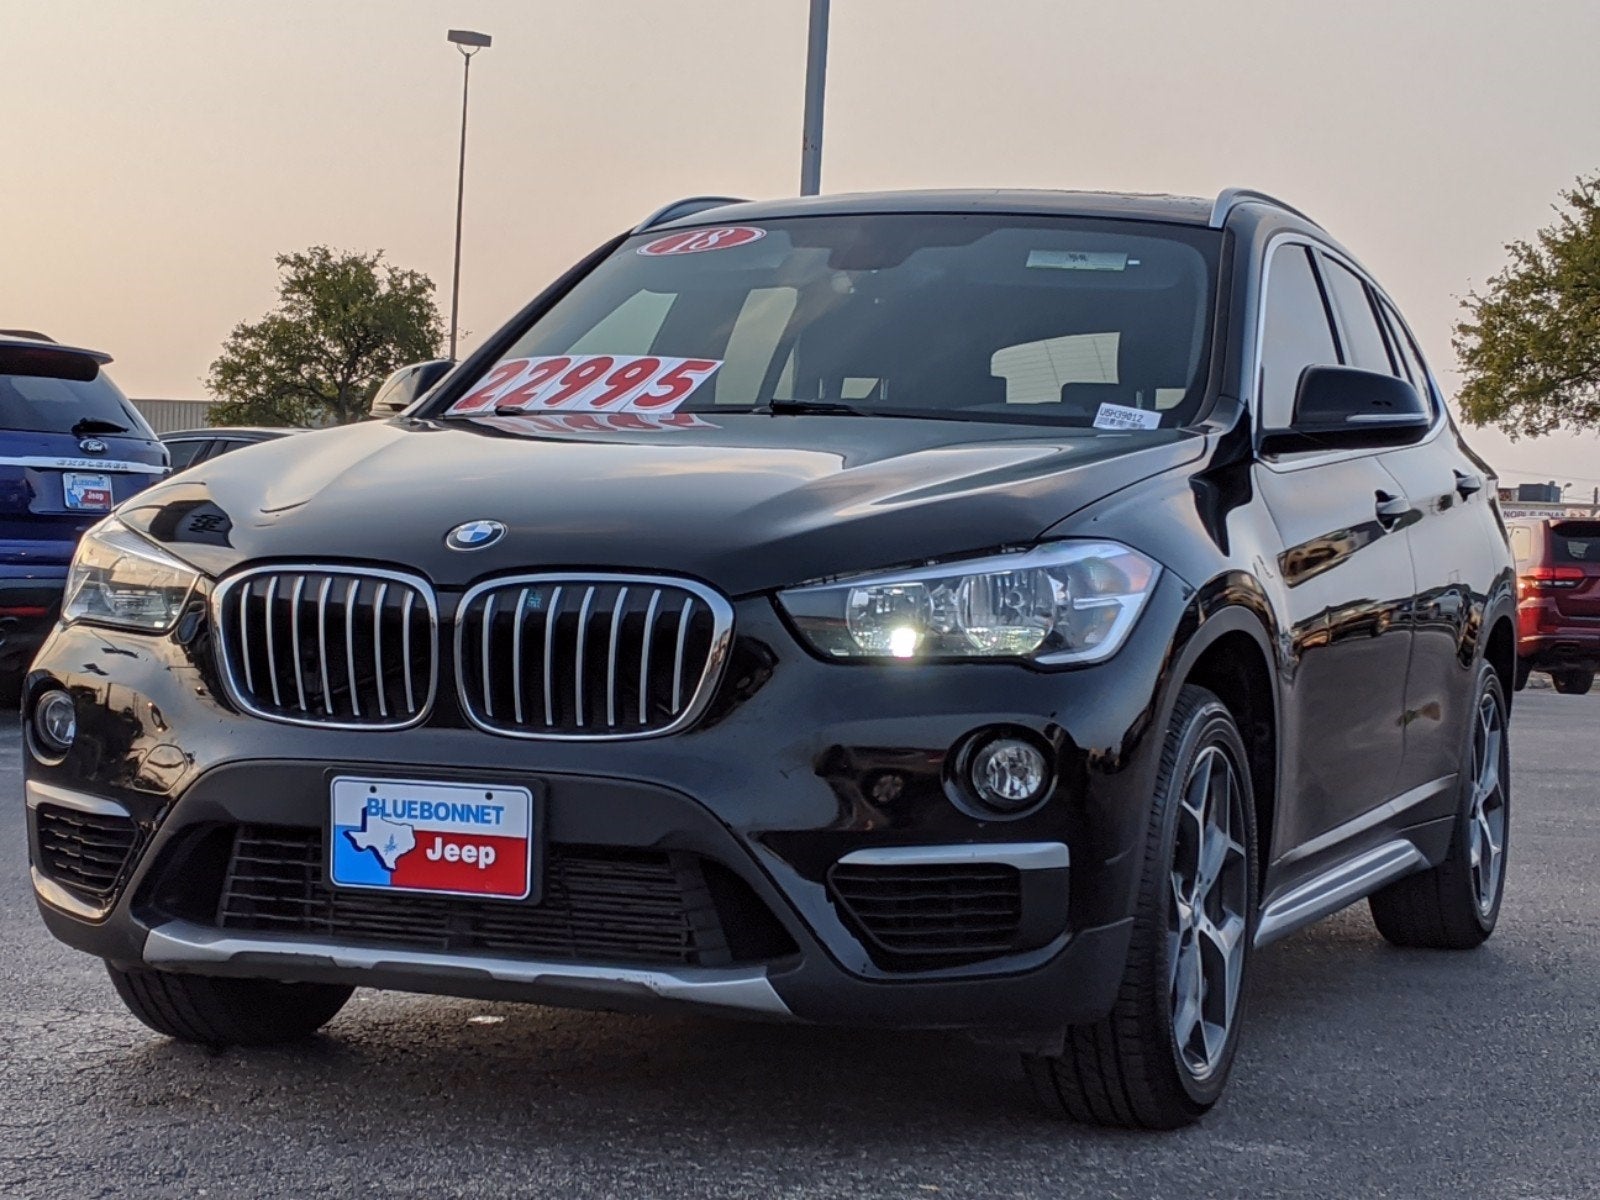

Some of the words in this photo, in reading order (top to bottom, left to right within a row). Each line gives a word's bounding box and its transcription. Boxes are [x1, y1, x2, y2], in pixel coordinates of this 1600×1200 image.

[665, 228, 735, 253] 18
[453, 357, 717, 411] 22995
[56, 460, 128, 469] EXPLORER
[87, 490, 105, 501] Jeep
[366, 797, 505, 825] BLUEBONNET
[425, 836, 496, 870] Jeep
